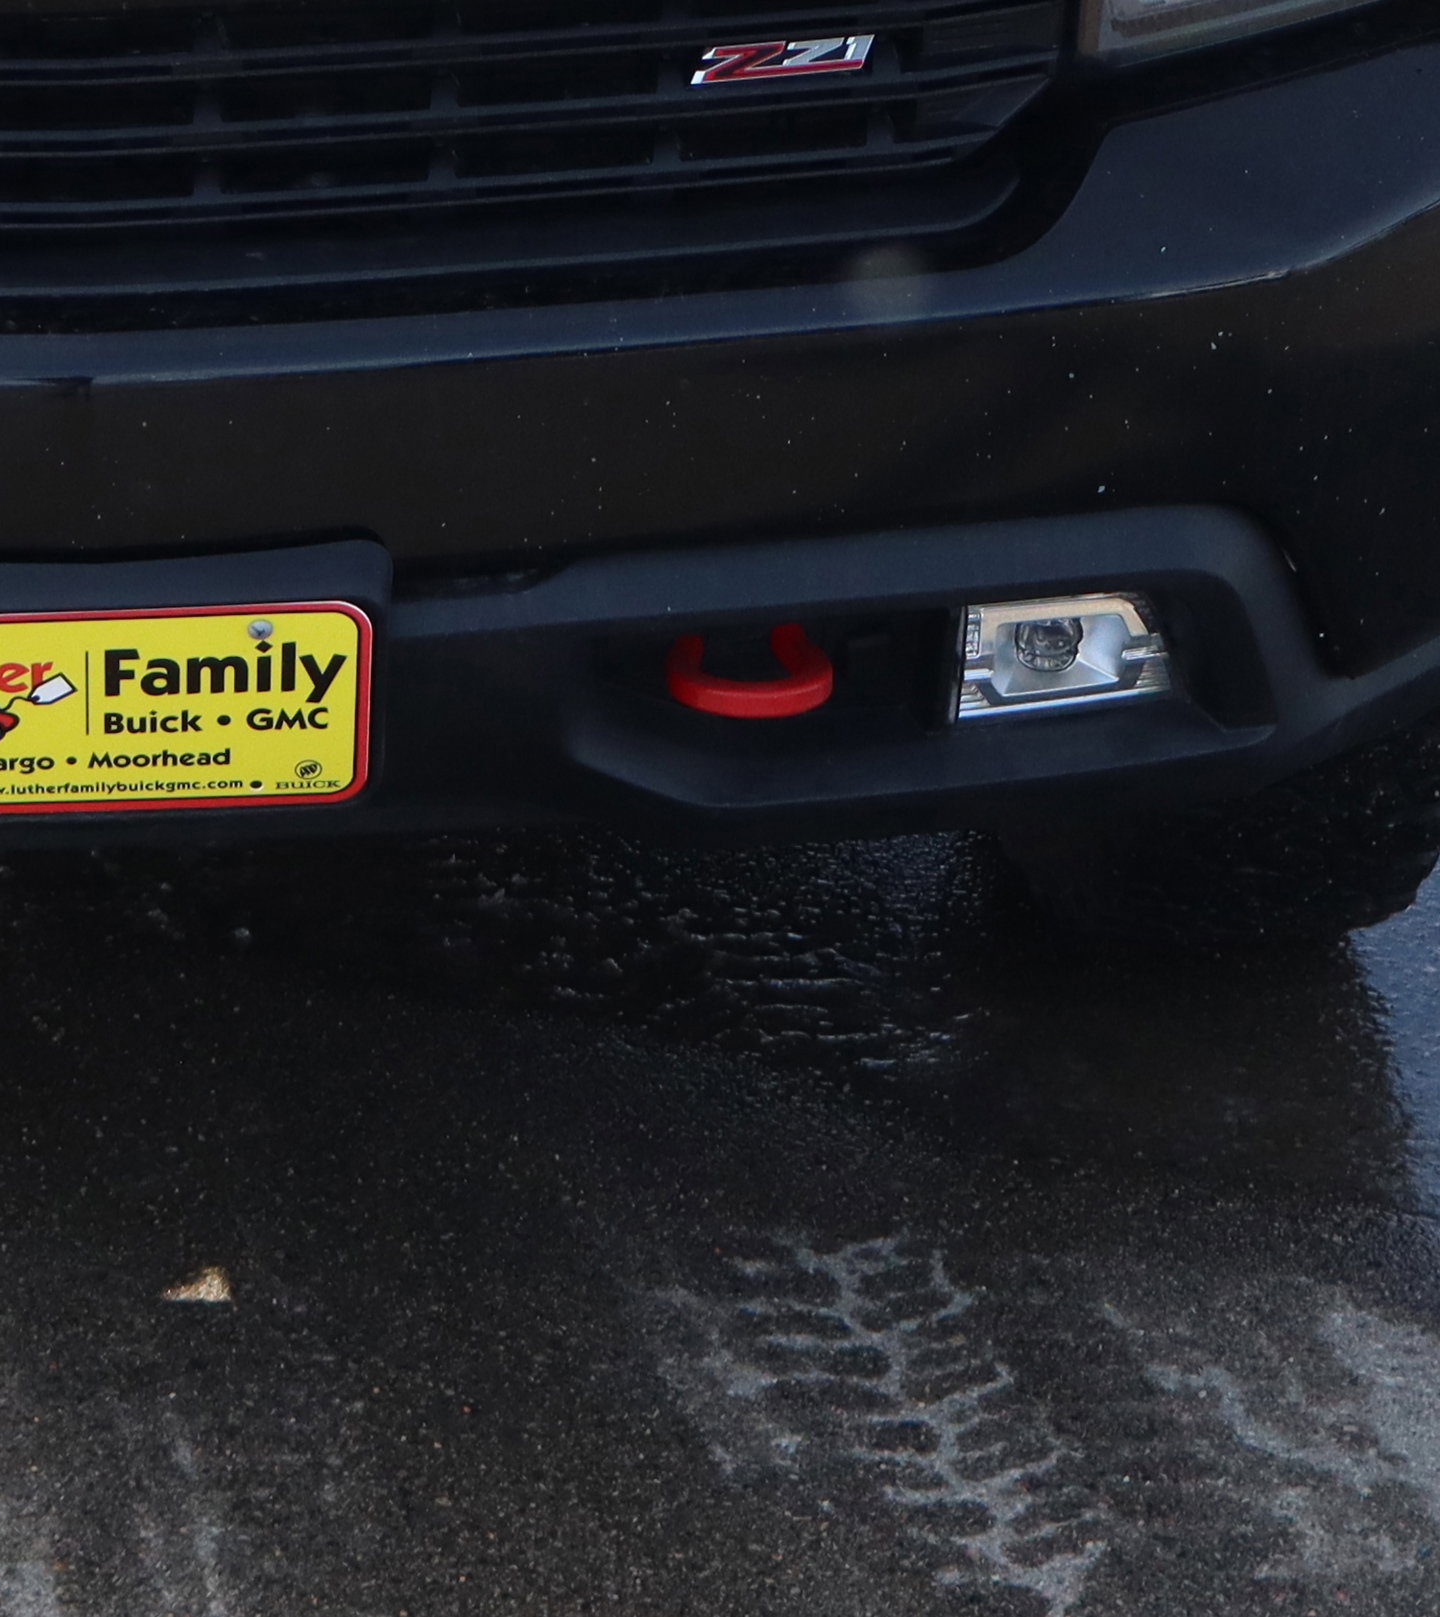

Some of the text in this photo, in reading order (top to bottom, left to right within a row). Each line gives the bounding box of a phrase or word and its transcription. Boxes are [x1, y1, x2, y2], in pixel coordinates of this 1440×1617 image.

[691, 35, 875, 84] Z71
[104, 640, 348, 704] Family
[104, 707, 329, 734] Buick GMC
[88, 748, 231, 769] Moorhead
[276, 780, 340, 789] BUICK
